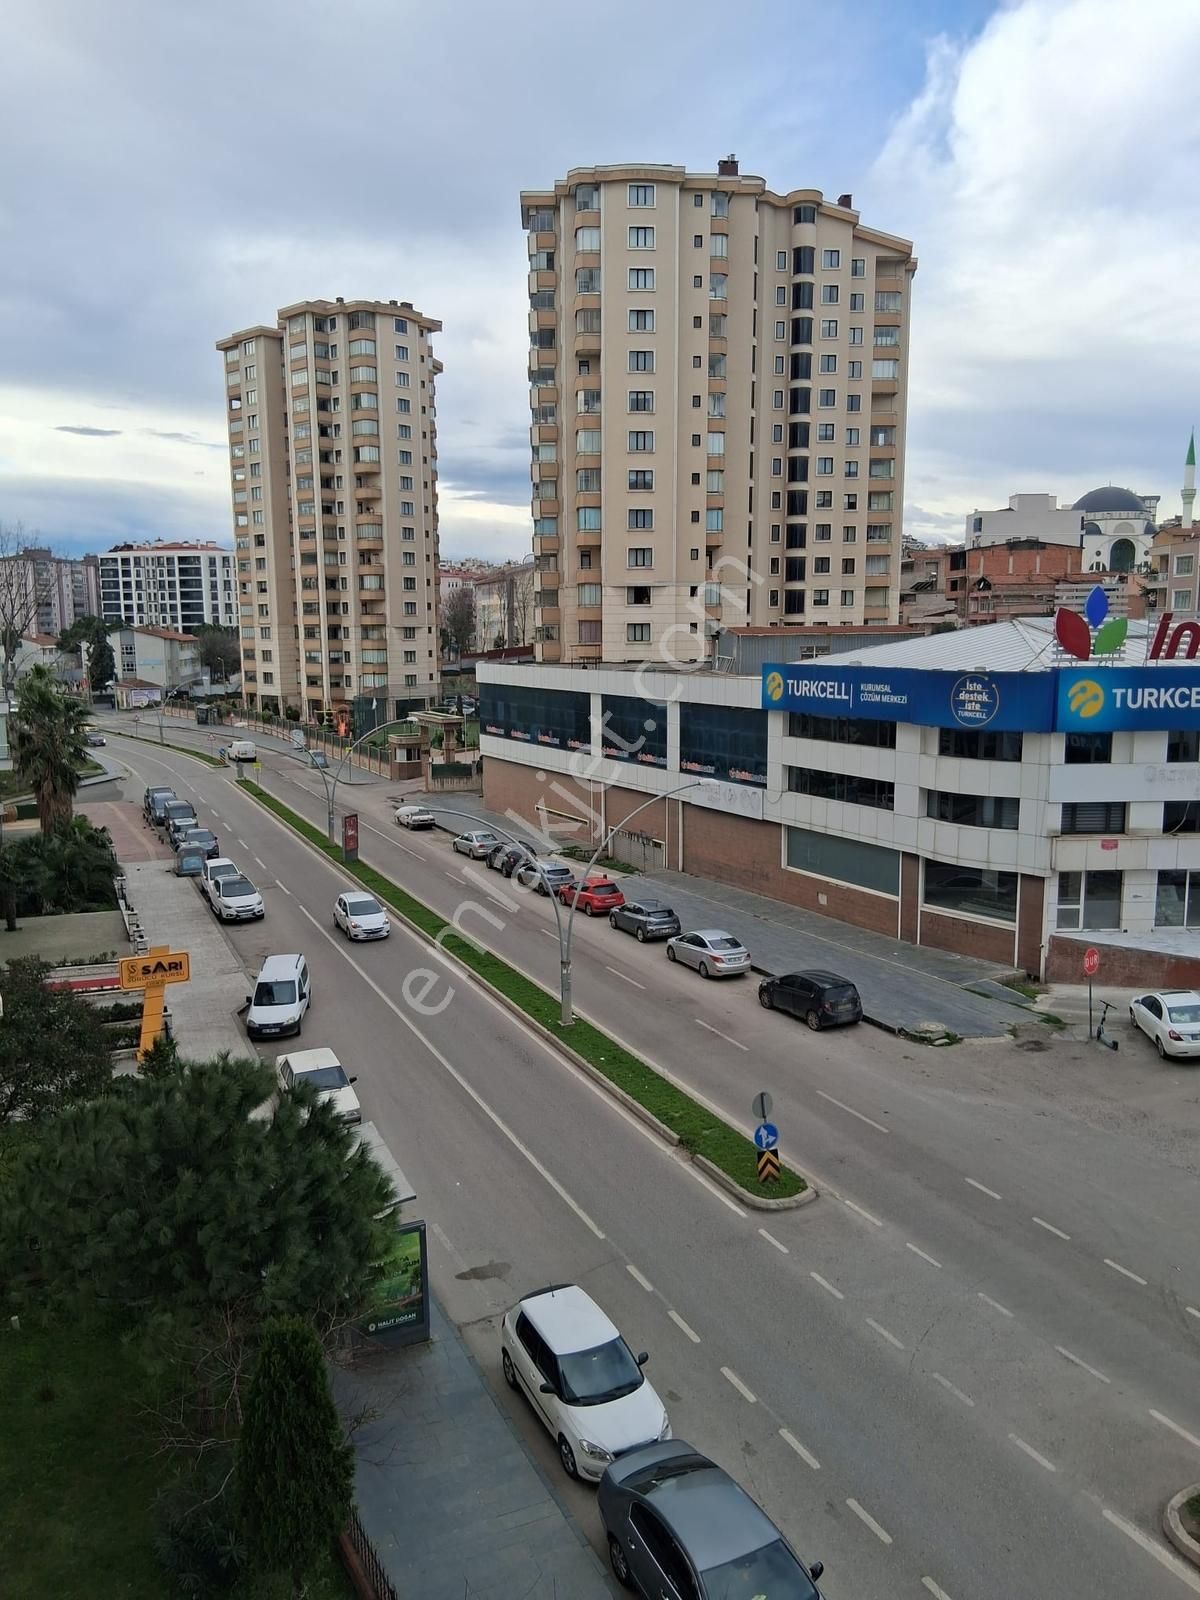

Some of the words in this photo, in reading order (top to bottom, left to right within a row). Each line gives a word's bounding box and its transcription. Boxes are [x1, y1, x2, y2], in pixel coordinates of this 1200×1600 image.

[786, 679, 849, 700] TURKCELL
[860, 683, 892, 693] KURUMSAL
[959, 690, 989, 702] destek
[1112, 687, 1200, 709] TURKCE
[957, 710, 988, 719] TURKCELL
[1085, 954, 1098, 968] DUR
